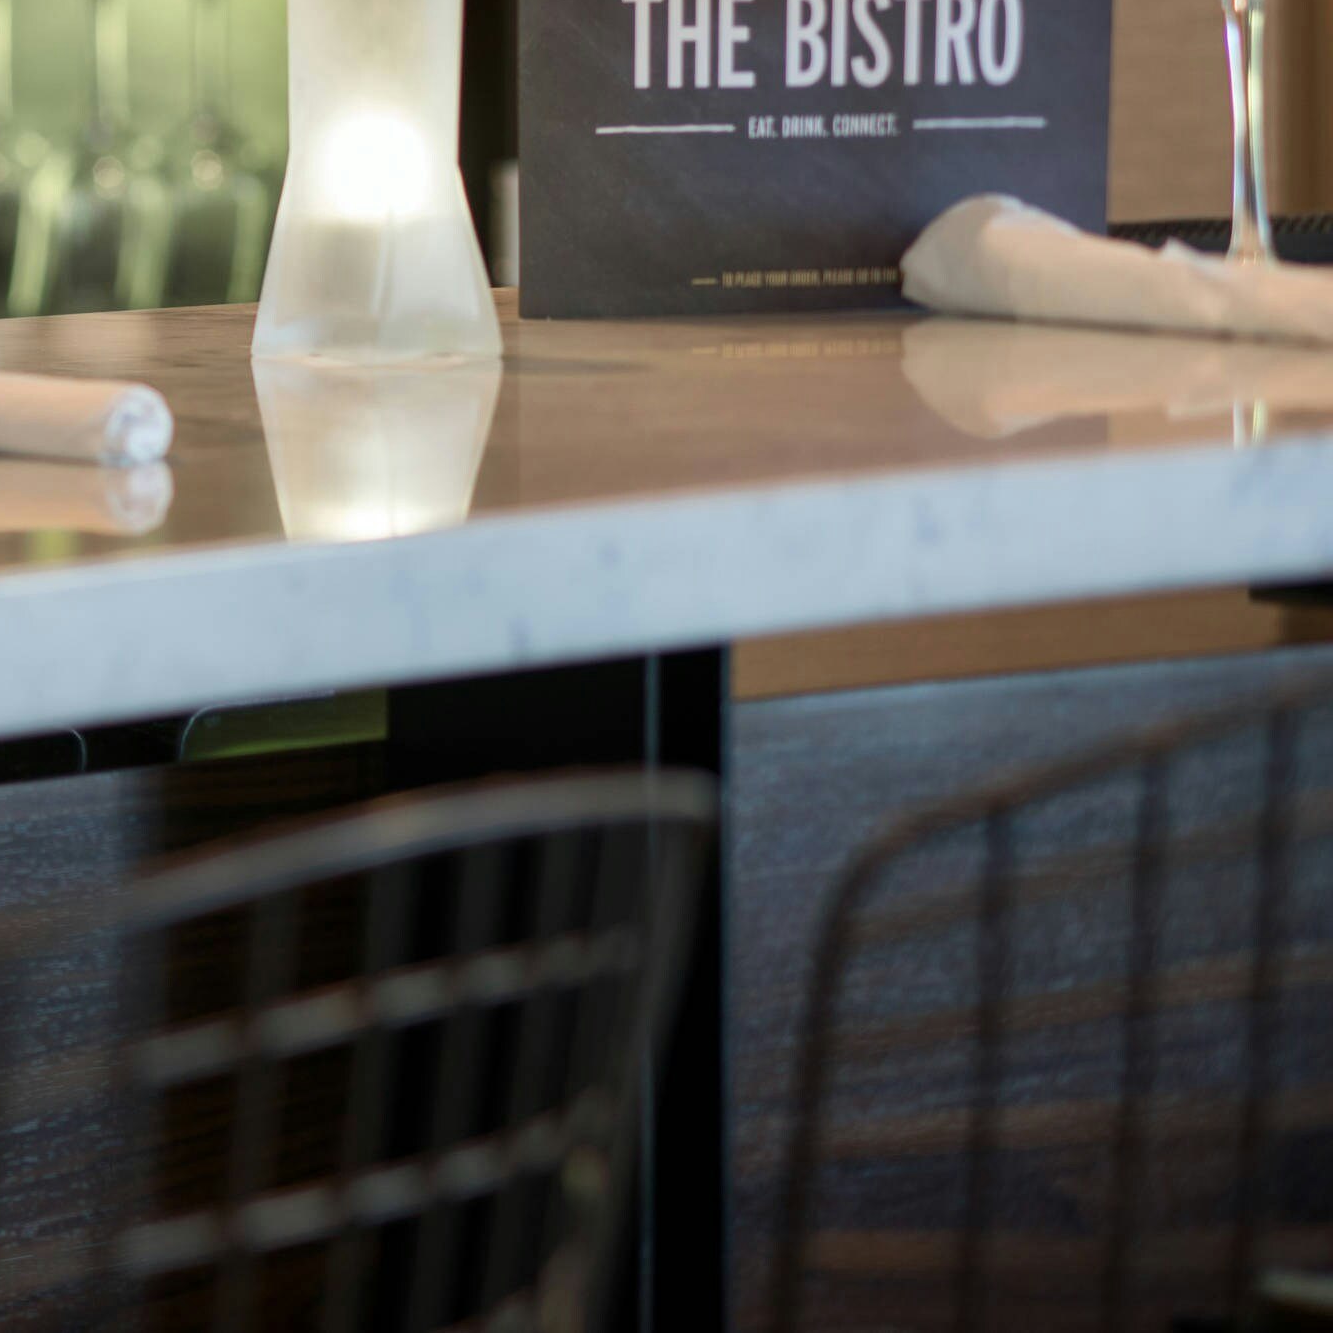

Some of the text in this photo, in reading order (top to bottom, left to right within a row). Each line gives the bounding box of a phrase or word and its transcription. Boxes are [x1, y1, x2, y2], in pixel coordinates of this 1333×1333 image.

[748, 112, 900, 139] EAT. DRINK. CONNECT.
